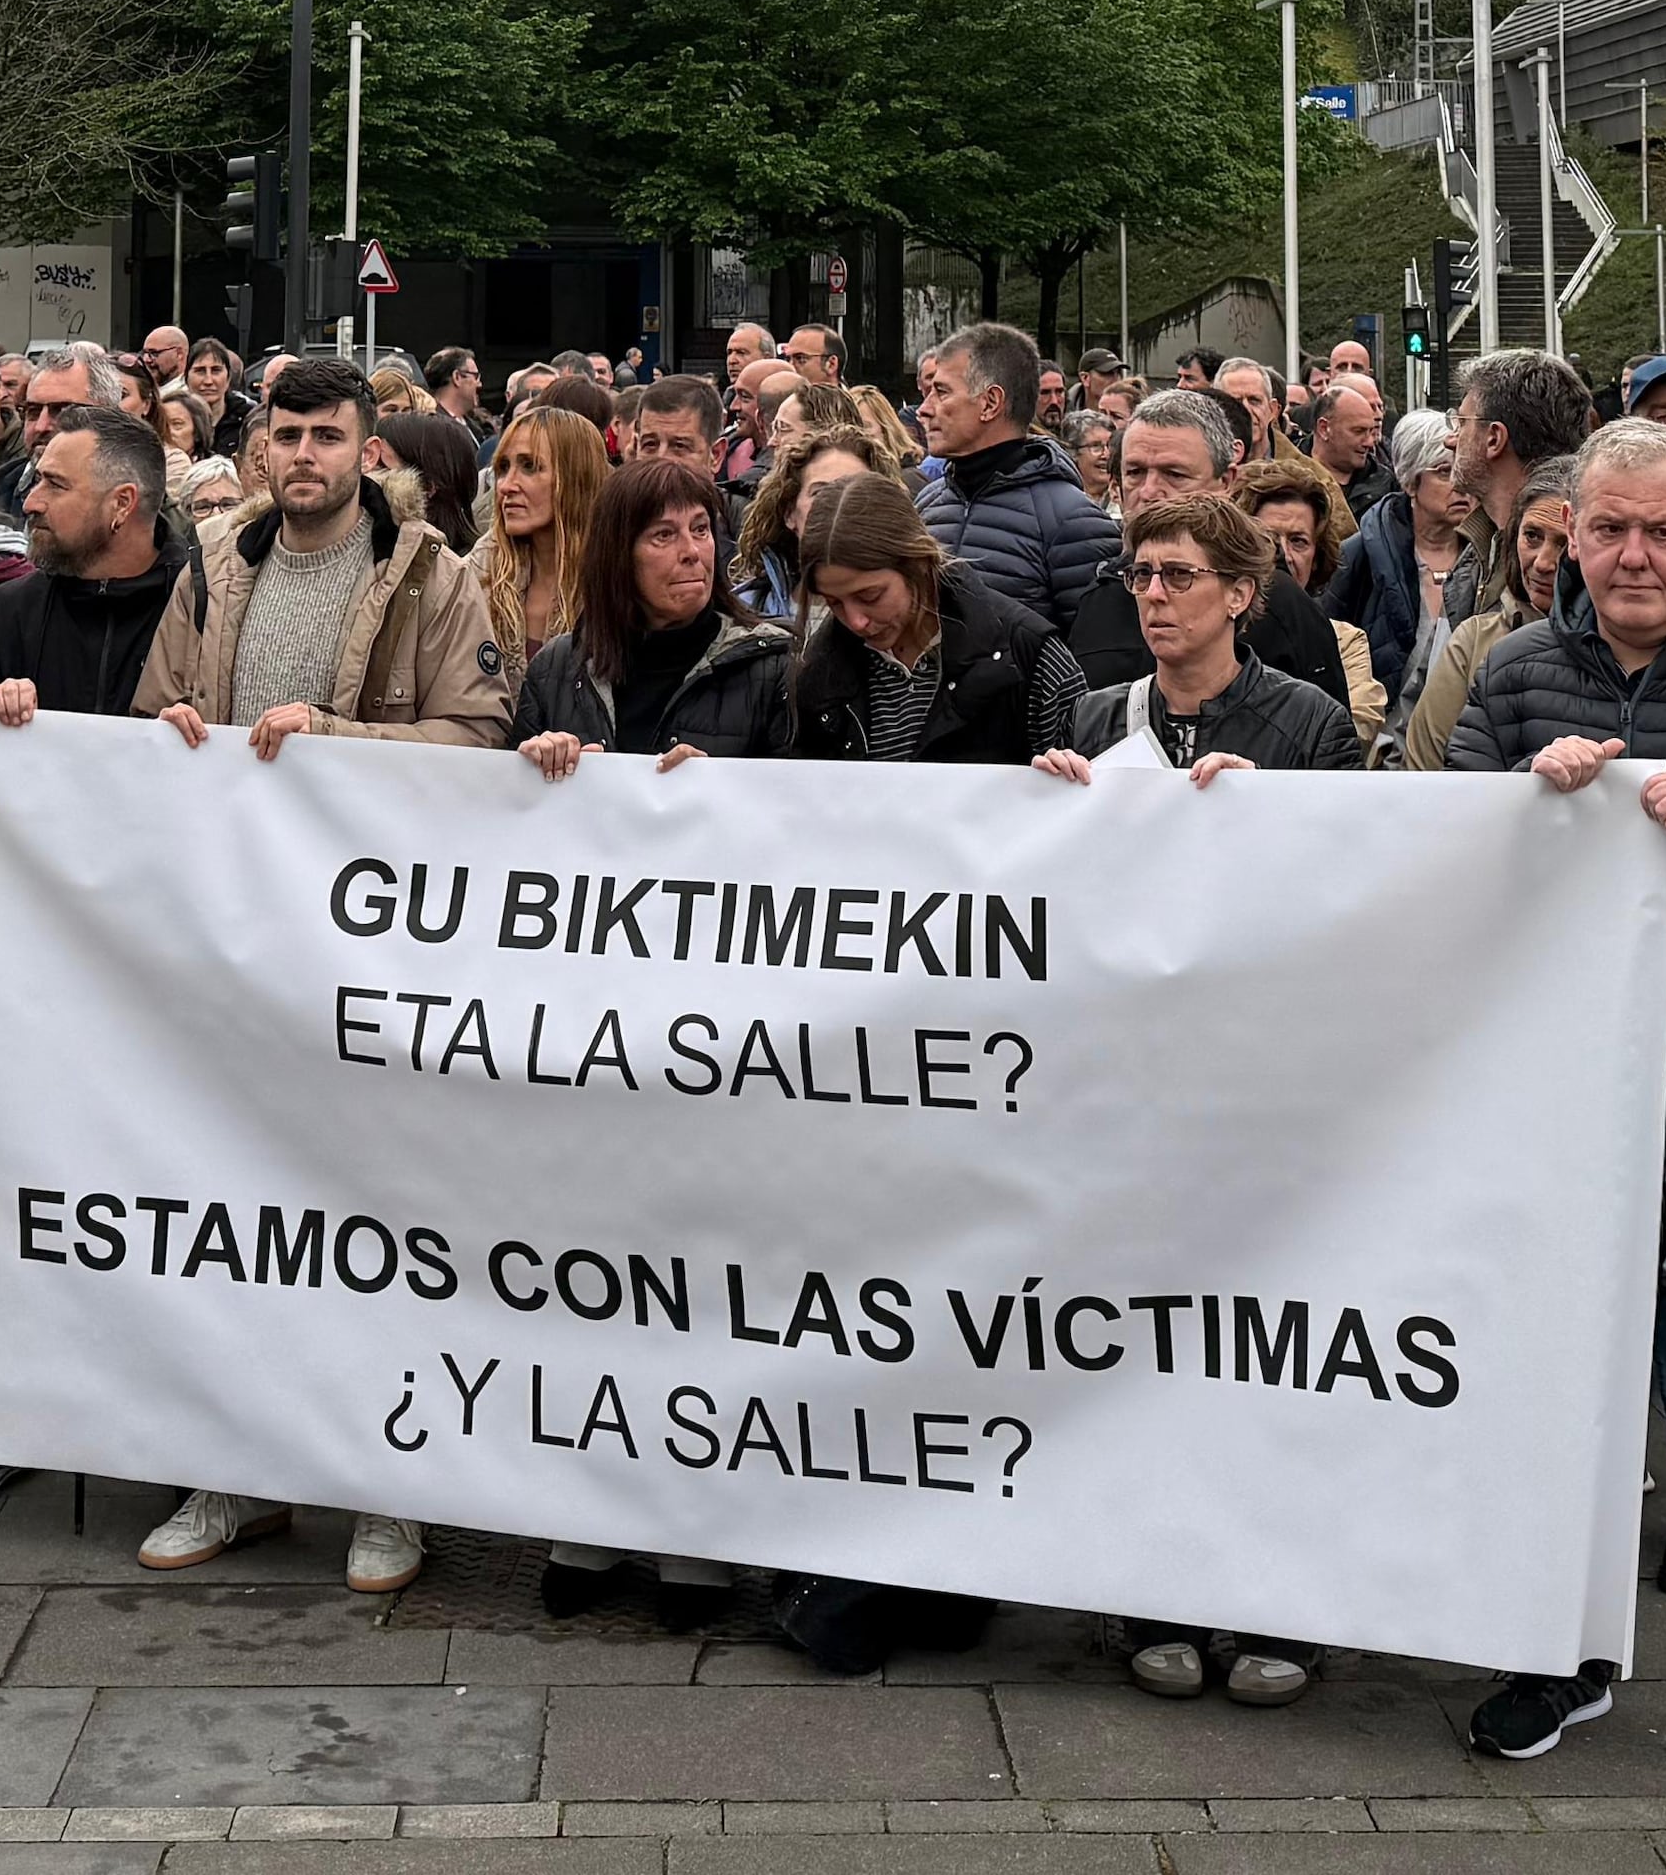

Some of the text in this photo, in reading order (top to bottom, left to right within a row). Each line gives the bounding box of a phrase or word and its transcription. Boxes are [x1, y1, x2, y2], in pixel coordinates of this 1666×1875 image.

[330, 857, 1047, 982] GU BIKTIMEKIN
[336, 986, 1034, 1113] ETA LA SALLE?
[18, 1187, 1460, 1408] ESTAMOS CON LAS VÍCTIMAS
[384, 1352, 1034, 1498] ¿Y LA SALLE?
